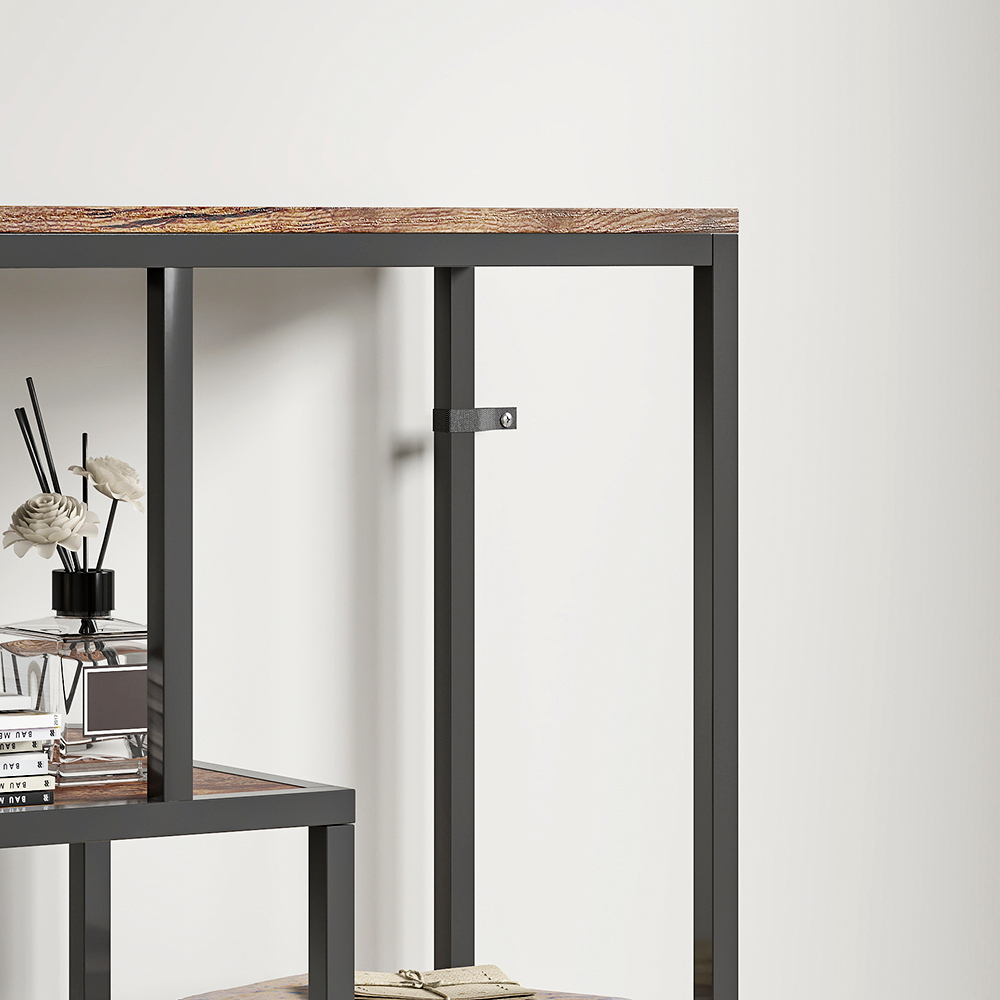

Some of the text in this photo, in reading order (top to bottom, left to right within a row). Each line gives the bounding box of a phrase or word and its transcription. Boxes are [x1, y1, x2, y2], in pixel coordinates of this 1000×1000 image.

[15, 730, 33, 739] BAU
[0, 742, 16, 750] BAU
[3, 762, 20, 770] BAU
[9, 781, 27, 789] BAU
[8, 795, 26, 804] BAU
